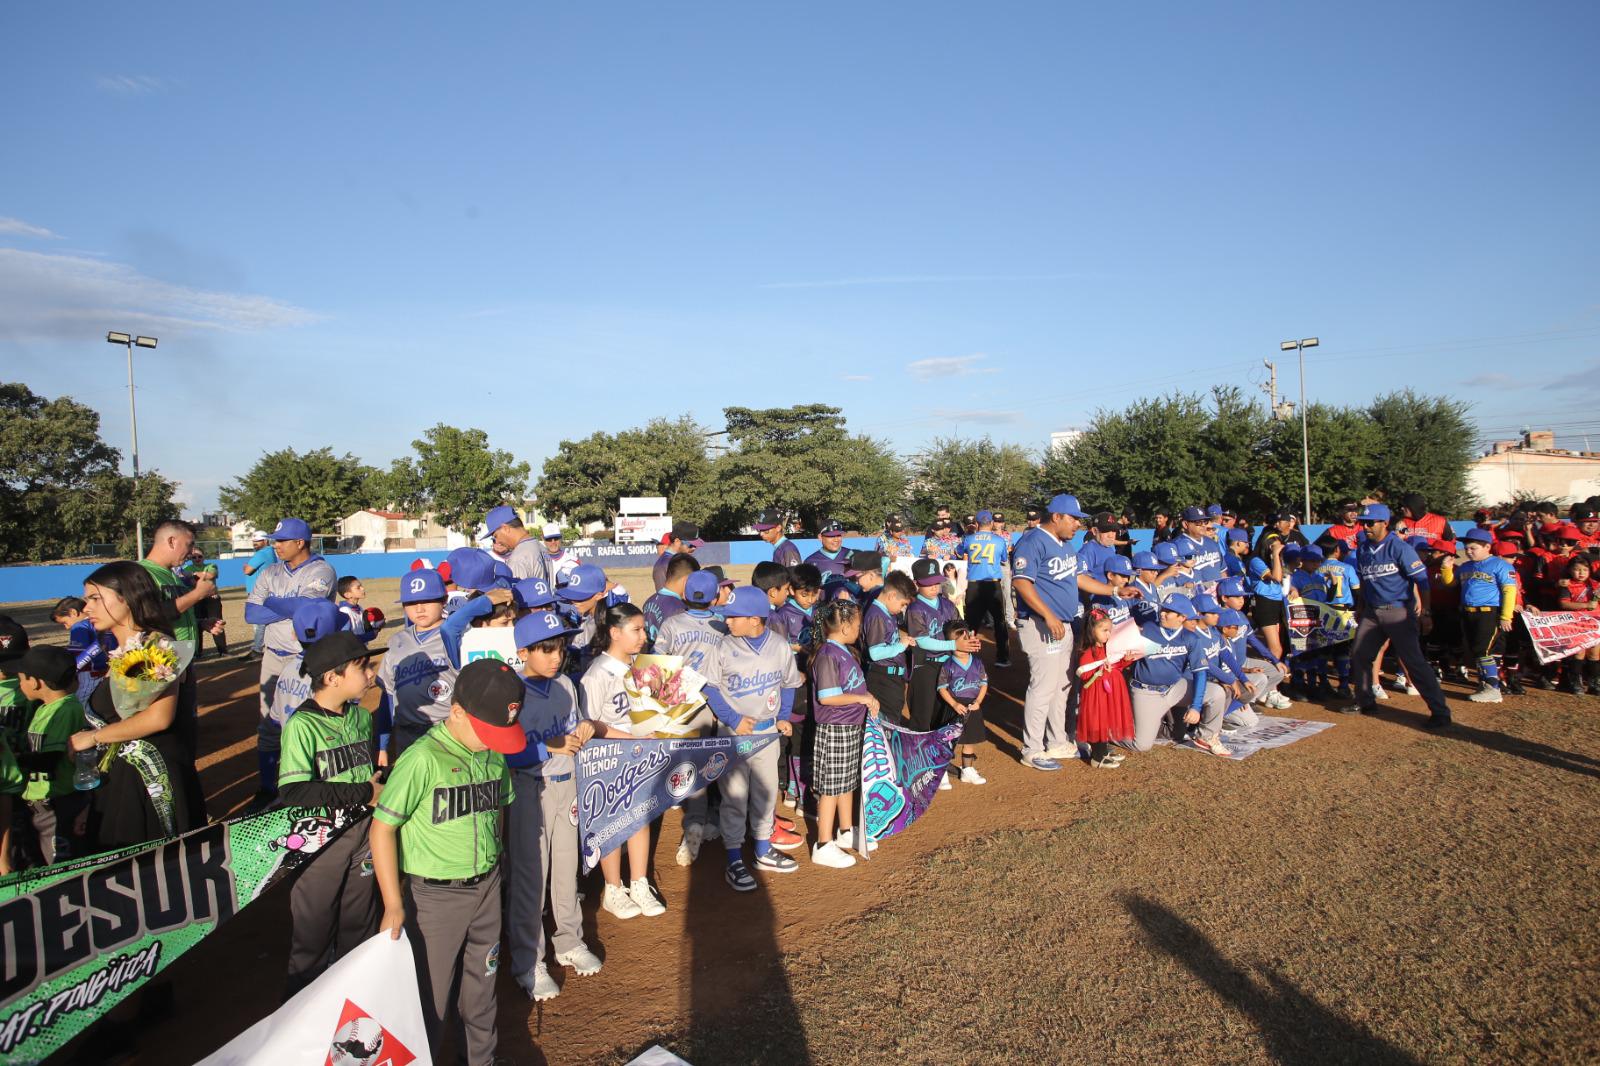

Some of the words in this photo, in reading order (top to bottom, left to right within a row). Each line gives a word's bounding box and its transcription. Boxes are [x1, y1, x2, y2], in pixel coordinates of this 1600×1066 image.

[598, 546, 626, 556] RAFAEL
[969, 543, 996, 565] 24
[410, 578, 426, 594] D
[534, 581, 548, 596] D
[570, 574, 581, 587] D
[544, 613, 560, 630] D
[277, 679, 309, 700] SALAZA
[727, 669, 783, 699] Dodgers
[578, 742, 624, 765] INFANTIL
[582, 757, 619, 779] MENOR
[583, 742, 672, 831] Dodgers
[68, 854, 120, 872] 2025-2026
[121, 846, 140, 858] LIGA
[43, 942, 159, 1026] PINGÜICA
